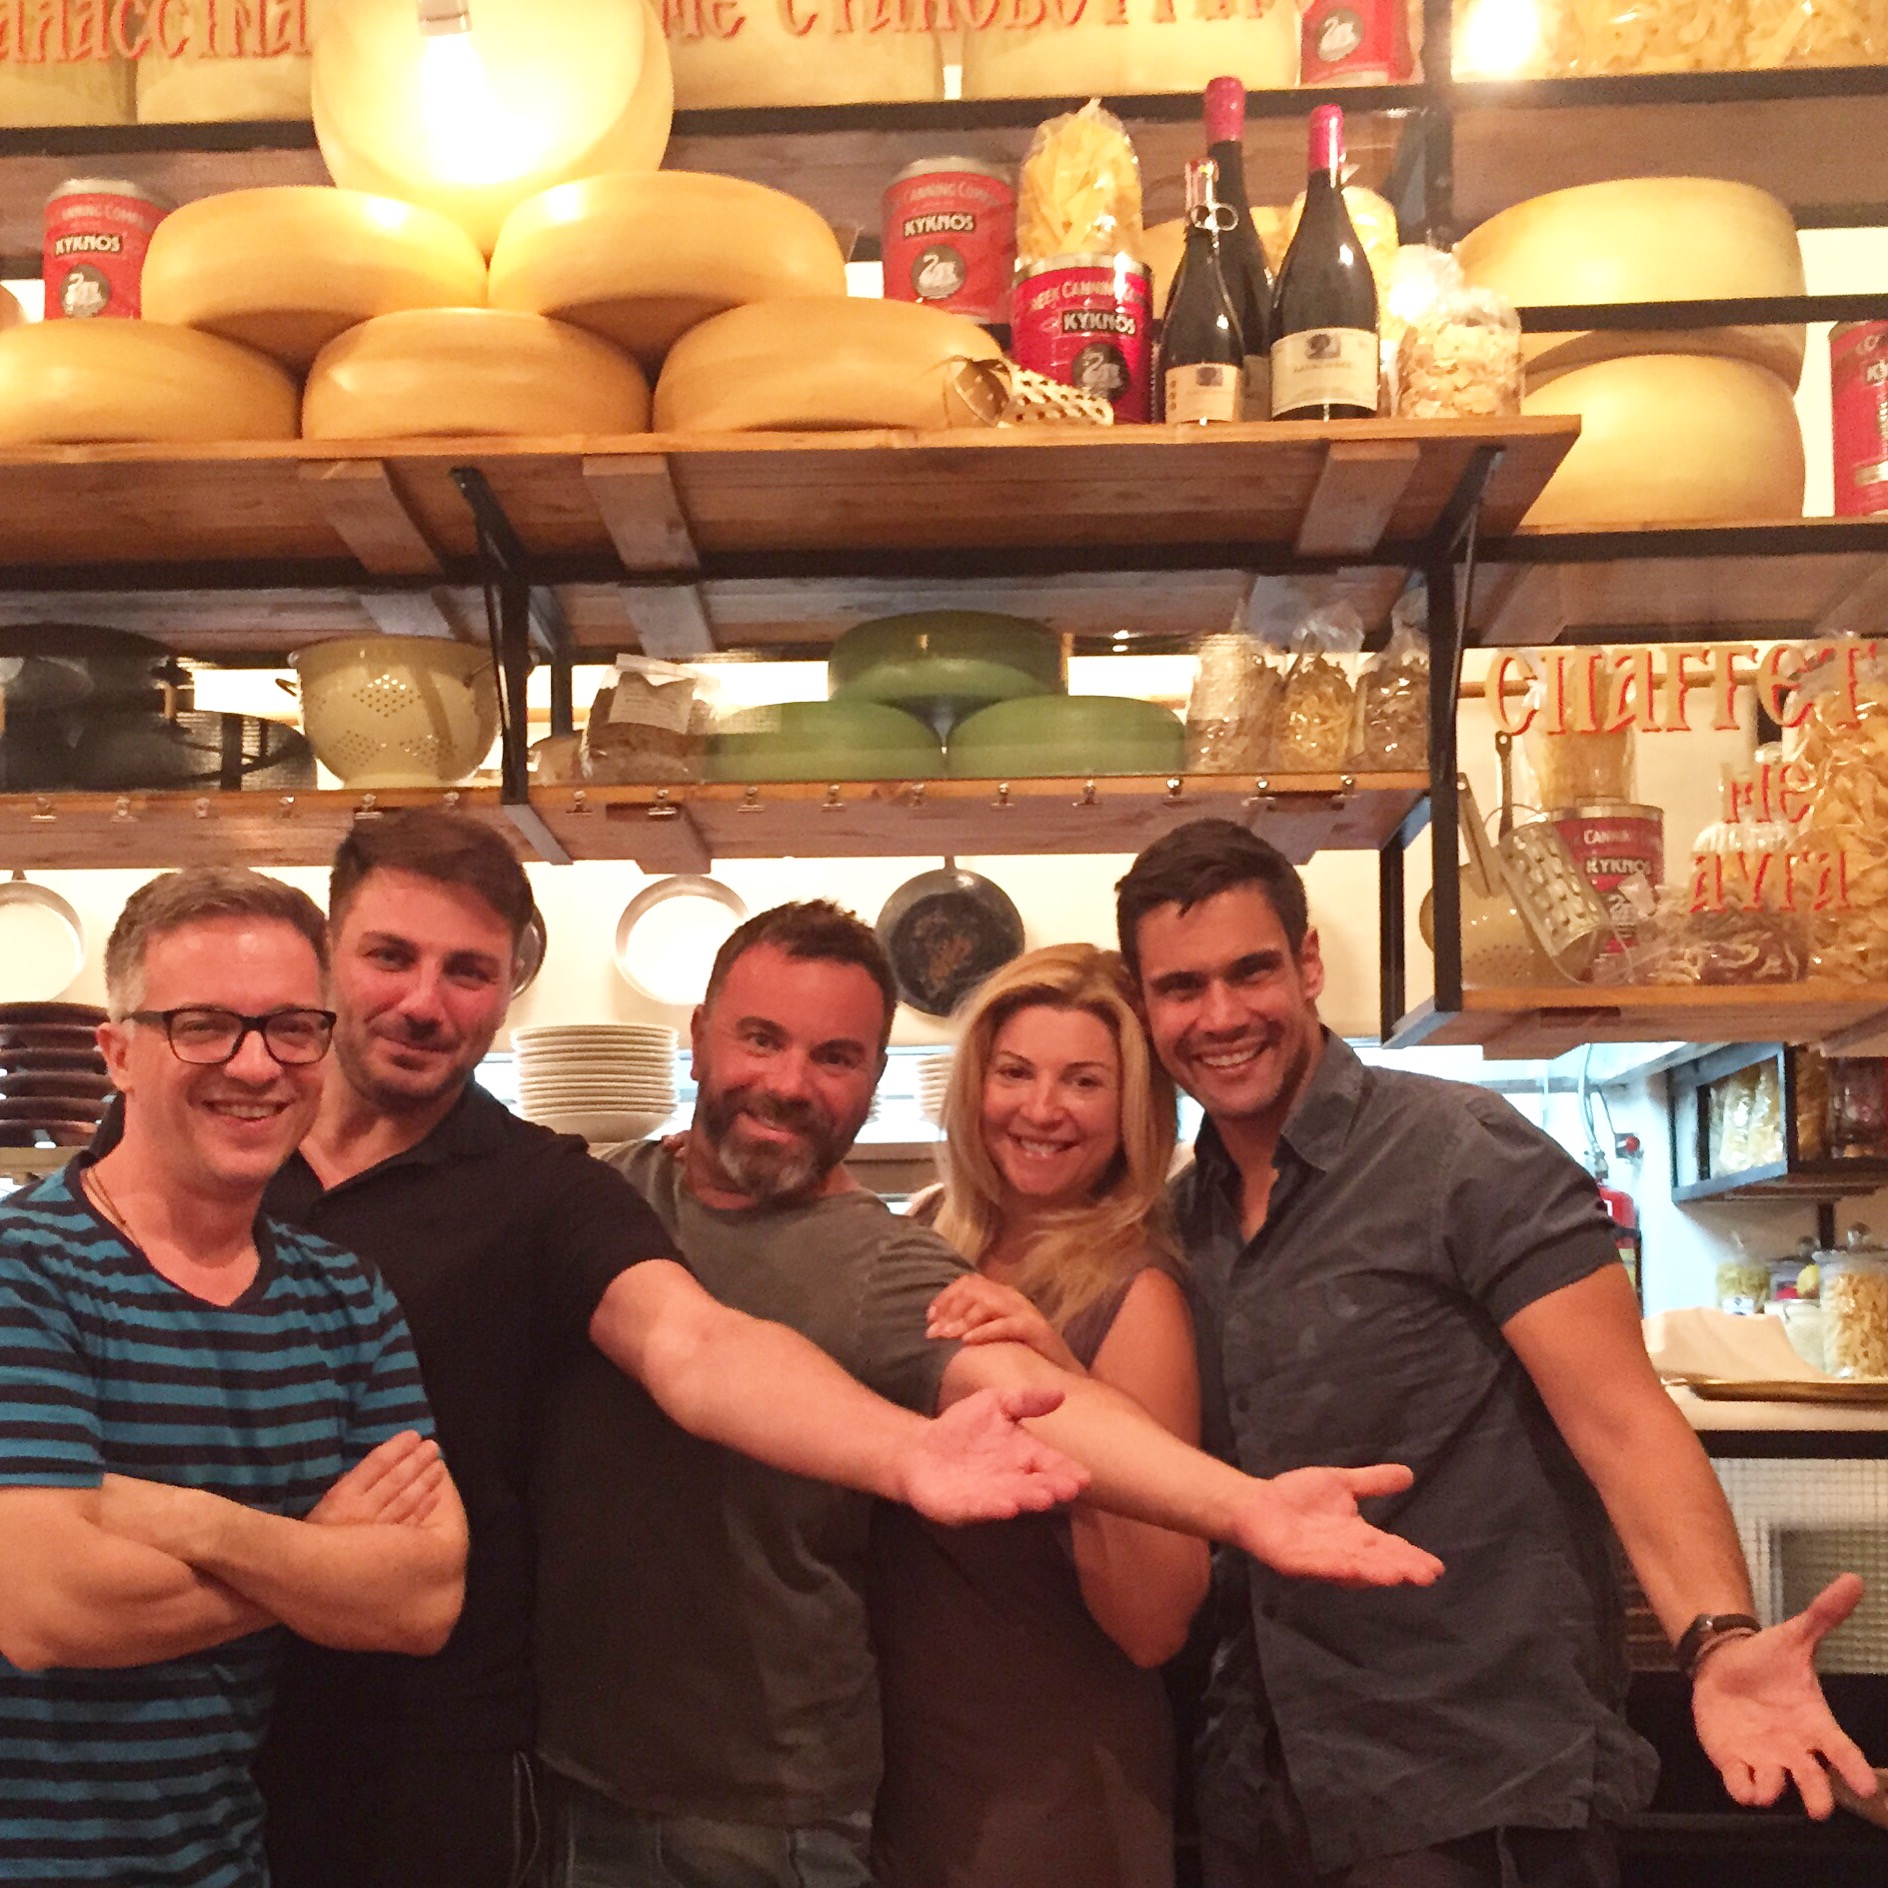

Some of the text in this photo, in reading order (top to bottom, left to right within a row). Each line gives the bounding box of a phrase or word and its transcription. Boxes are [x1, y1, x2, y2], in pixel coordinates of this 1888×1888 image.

[903, 215, 974, 237] KYKNOS
[56, 236, 121, 256] KYKNOS
[1063, 312, 1136, 335] KYKNOS
